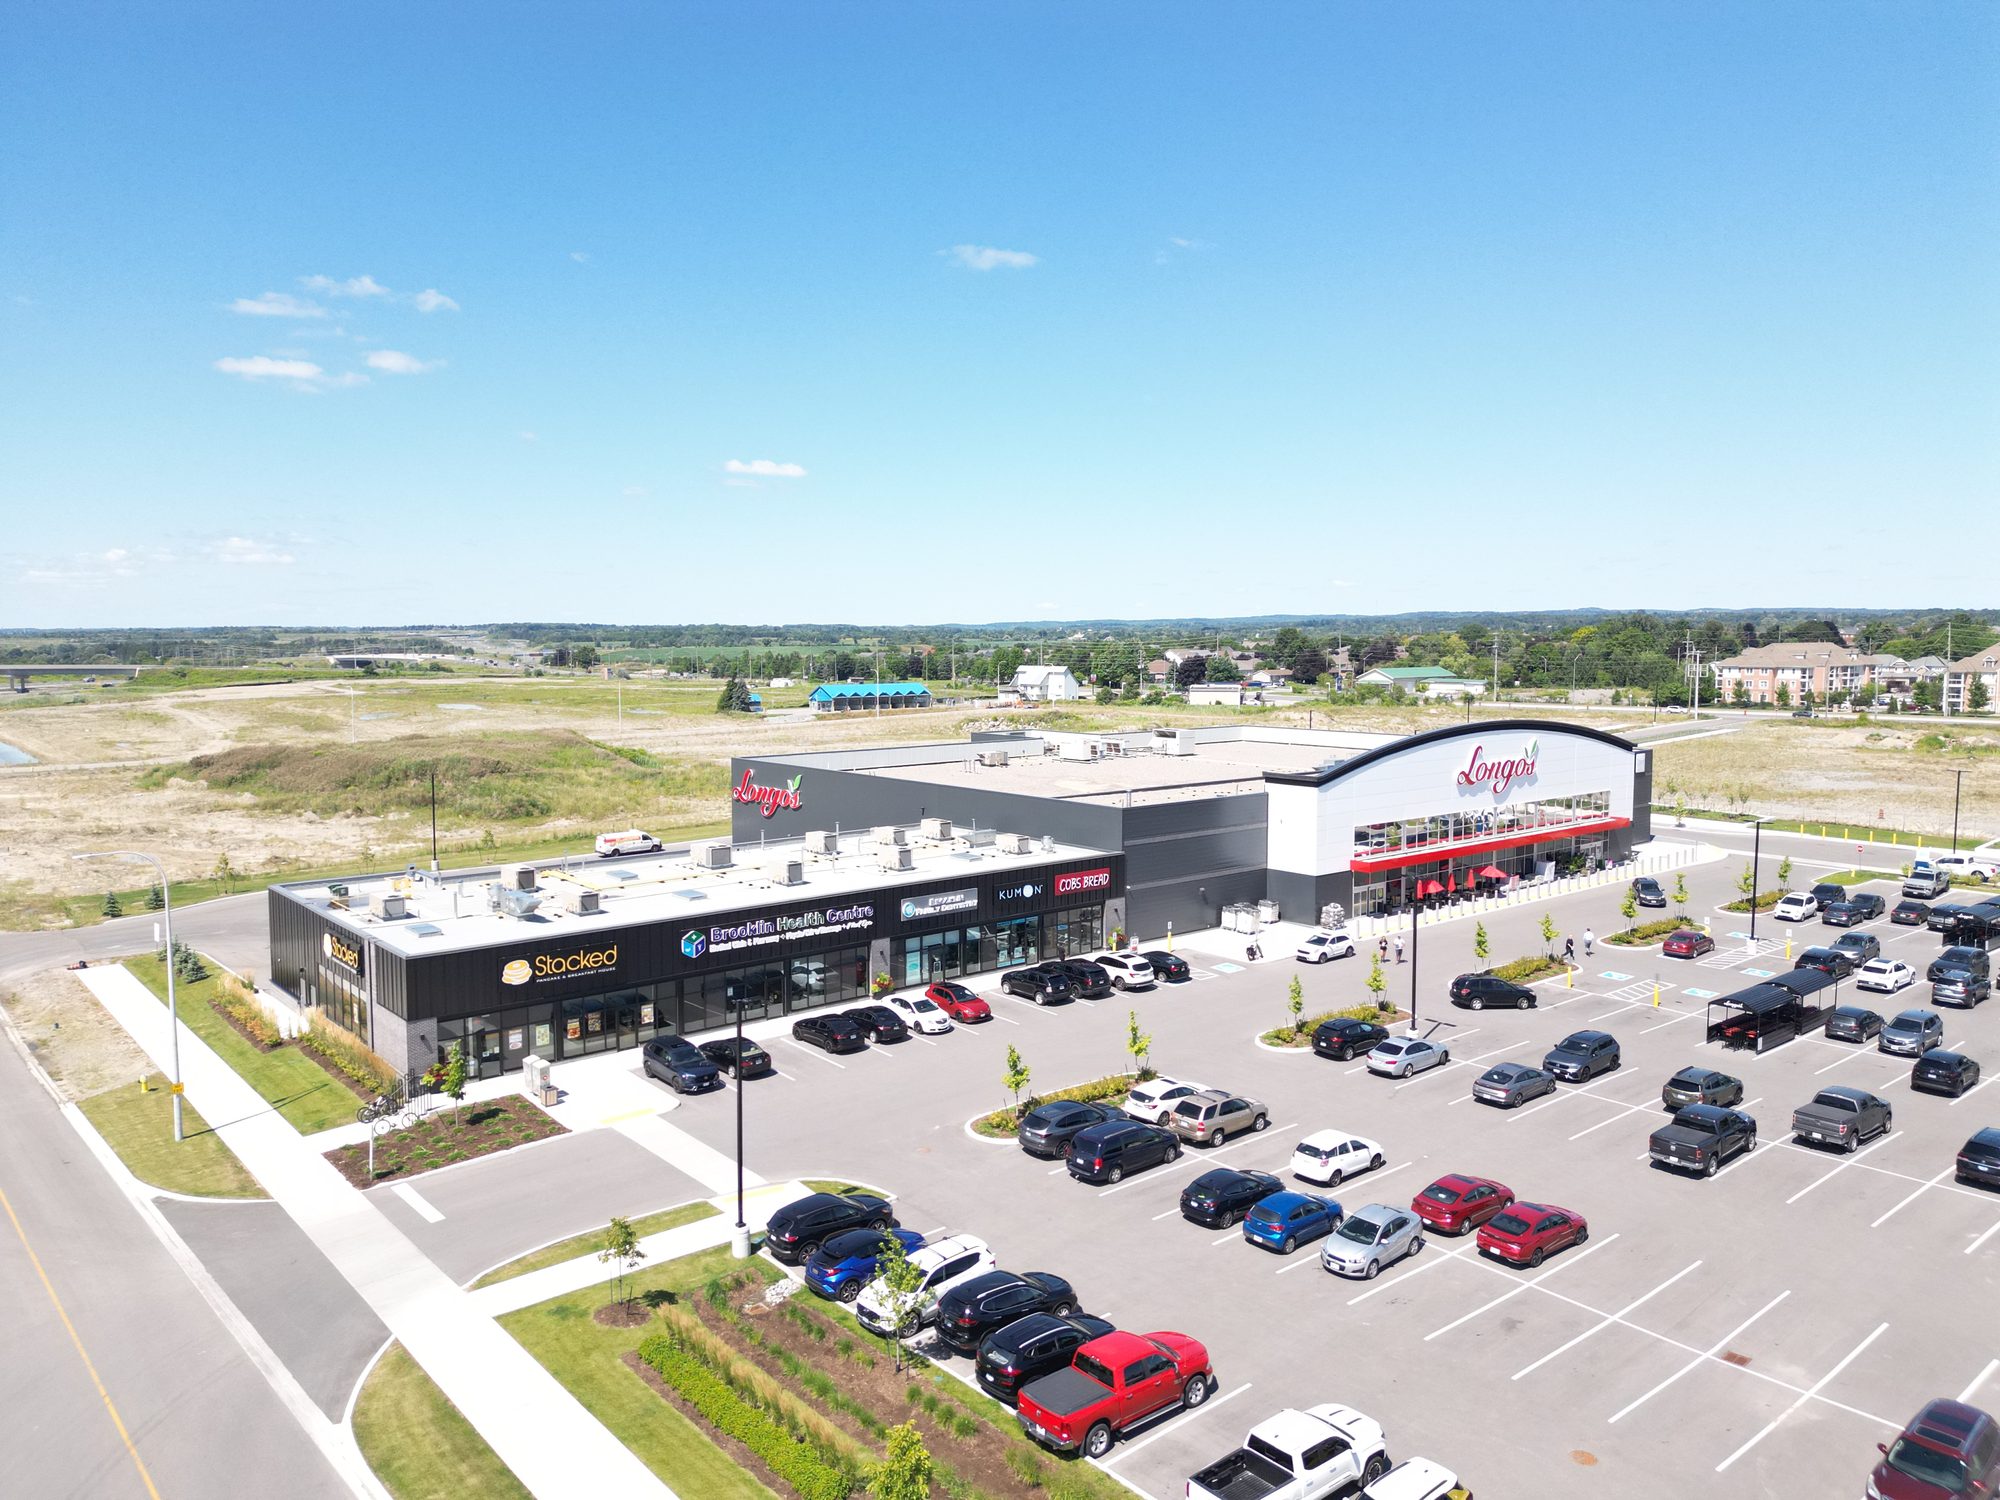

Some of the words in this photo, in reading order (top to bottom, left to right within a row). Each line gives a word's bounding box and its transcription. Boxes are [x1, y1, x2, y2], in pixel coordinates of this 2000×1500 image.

[999, 884, 1043, 900] KUMON
[1059, 877, 1081, 892] COBS
[1083, 873, 1109, 888] BREAD
[710, 920, 775, 942] Brooklin
[776, 911, 824, 931] Health
[826, 905, 873, 923] Centre
[535, 945, 617, 976] Stacked
